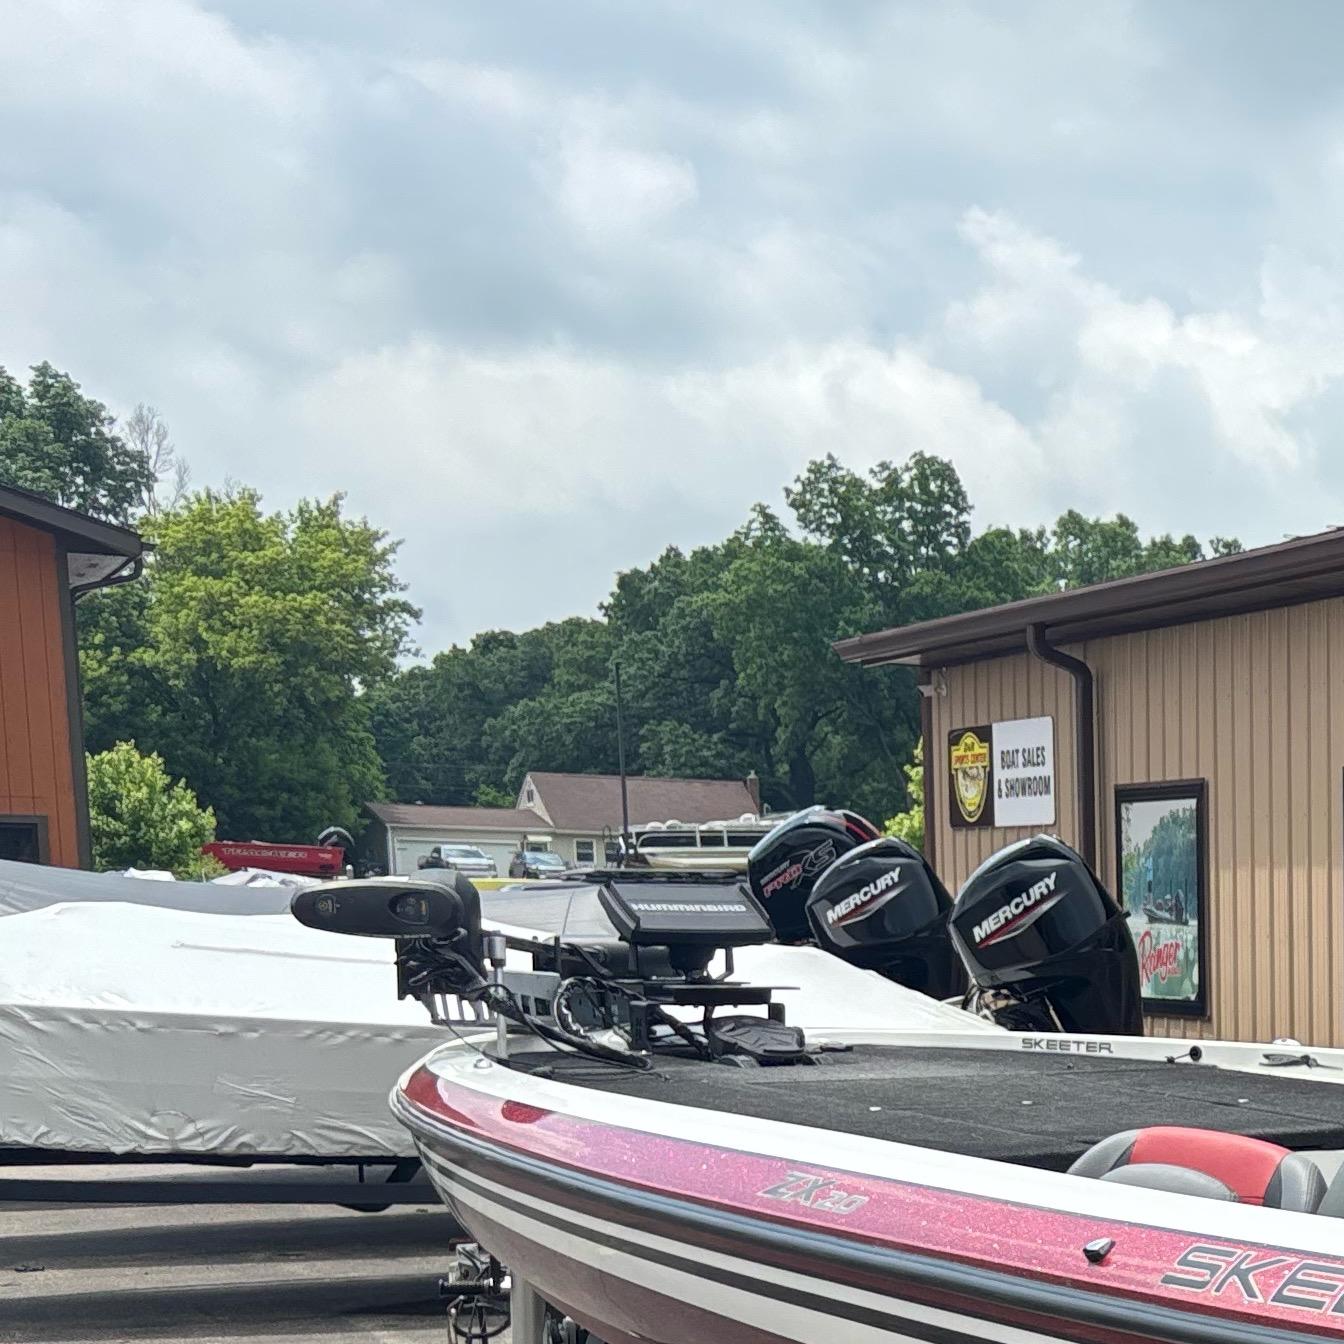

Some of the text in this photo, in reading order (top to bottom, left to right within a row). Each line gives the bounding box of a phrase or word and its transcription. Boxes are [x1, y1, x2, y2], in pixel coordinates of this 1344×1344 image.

[1000, 746, 1046, 770] BOAT SALES
[1005, 775, 1051, 799] SHOWROOM
[629, 902, 747, 913] HUMMINBIRD
[826, 867, 901, 925] MERCURY
[972, 872, 1057, 943] MERCURY
[1020, 1038, 1114, 1054] SKEETER
